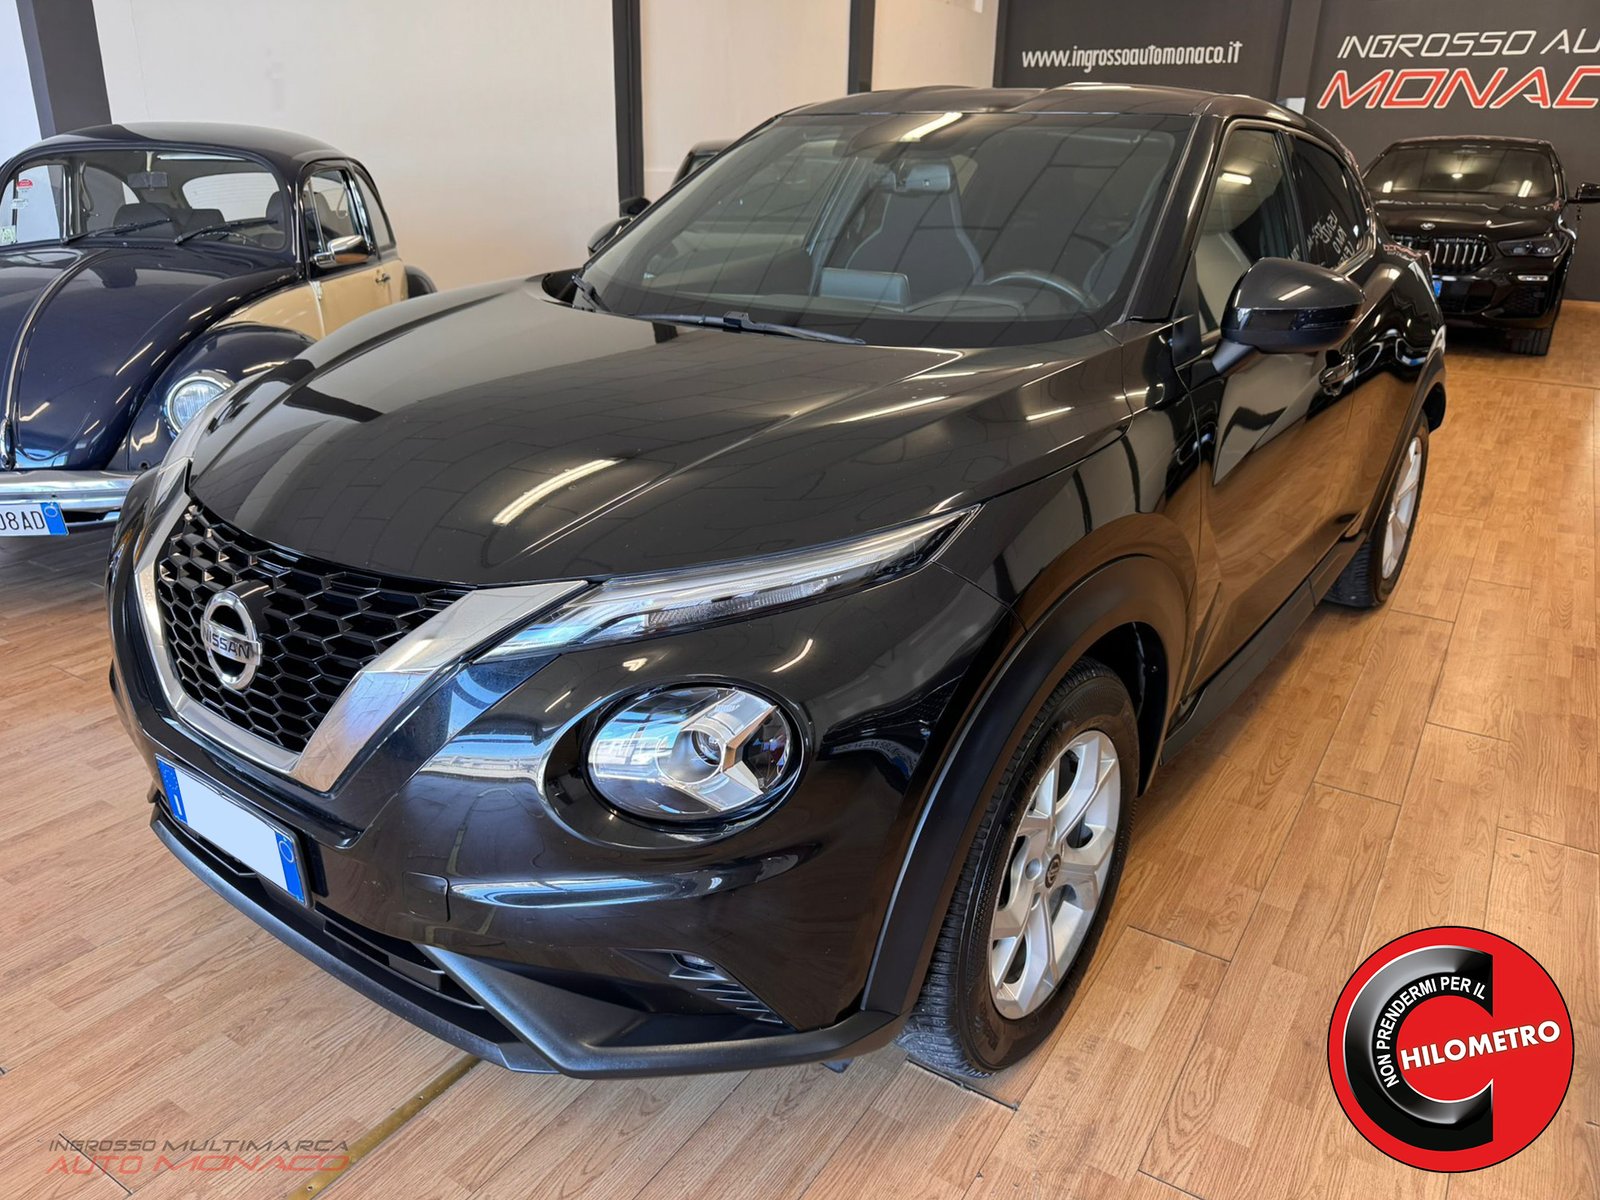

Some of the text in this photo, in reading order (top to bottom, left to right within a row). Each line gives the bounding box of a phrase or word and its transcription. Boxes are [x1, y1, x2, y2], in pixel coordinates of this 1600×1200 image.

[1022, 40, 1243, 74] www.ingrossoautomonaco.it
[1337, 28, 1600, 59] INGROSSO AU
[1316, 65, 1600, 110] MONAC
[203, 624, 254, 660] NISSAN
